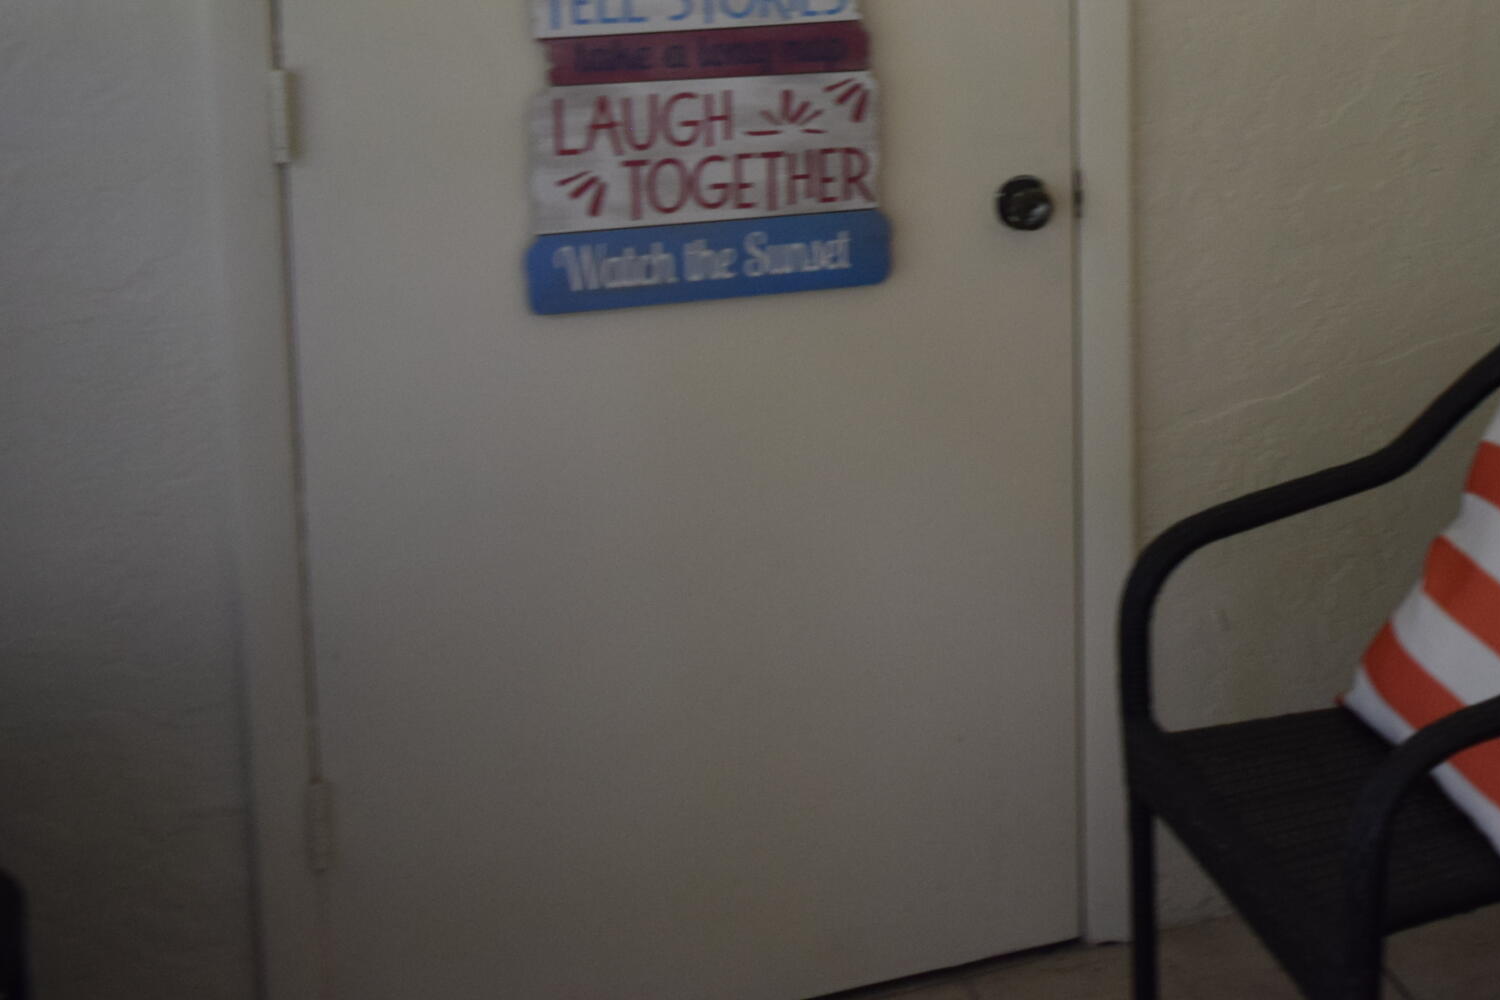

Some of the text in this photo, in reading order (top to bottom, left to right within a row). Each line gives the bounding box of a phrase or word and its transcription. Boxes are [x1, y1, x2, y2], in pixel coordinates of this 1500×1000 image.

[553, 89, 735, 157] LAUGH
[621, 146, 876, 221] TOGETHER
[553, 231, 853, 292] Watch the Sunset
